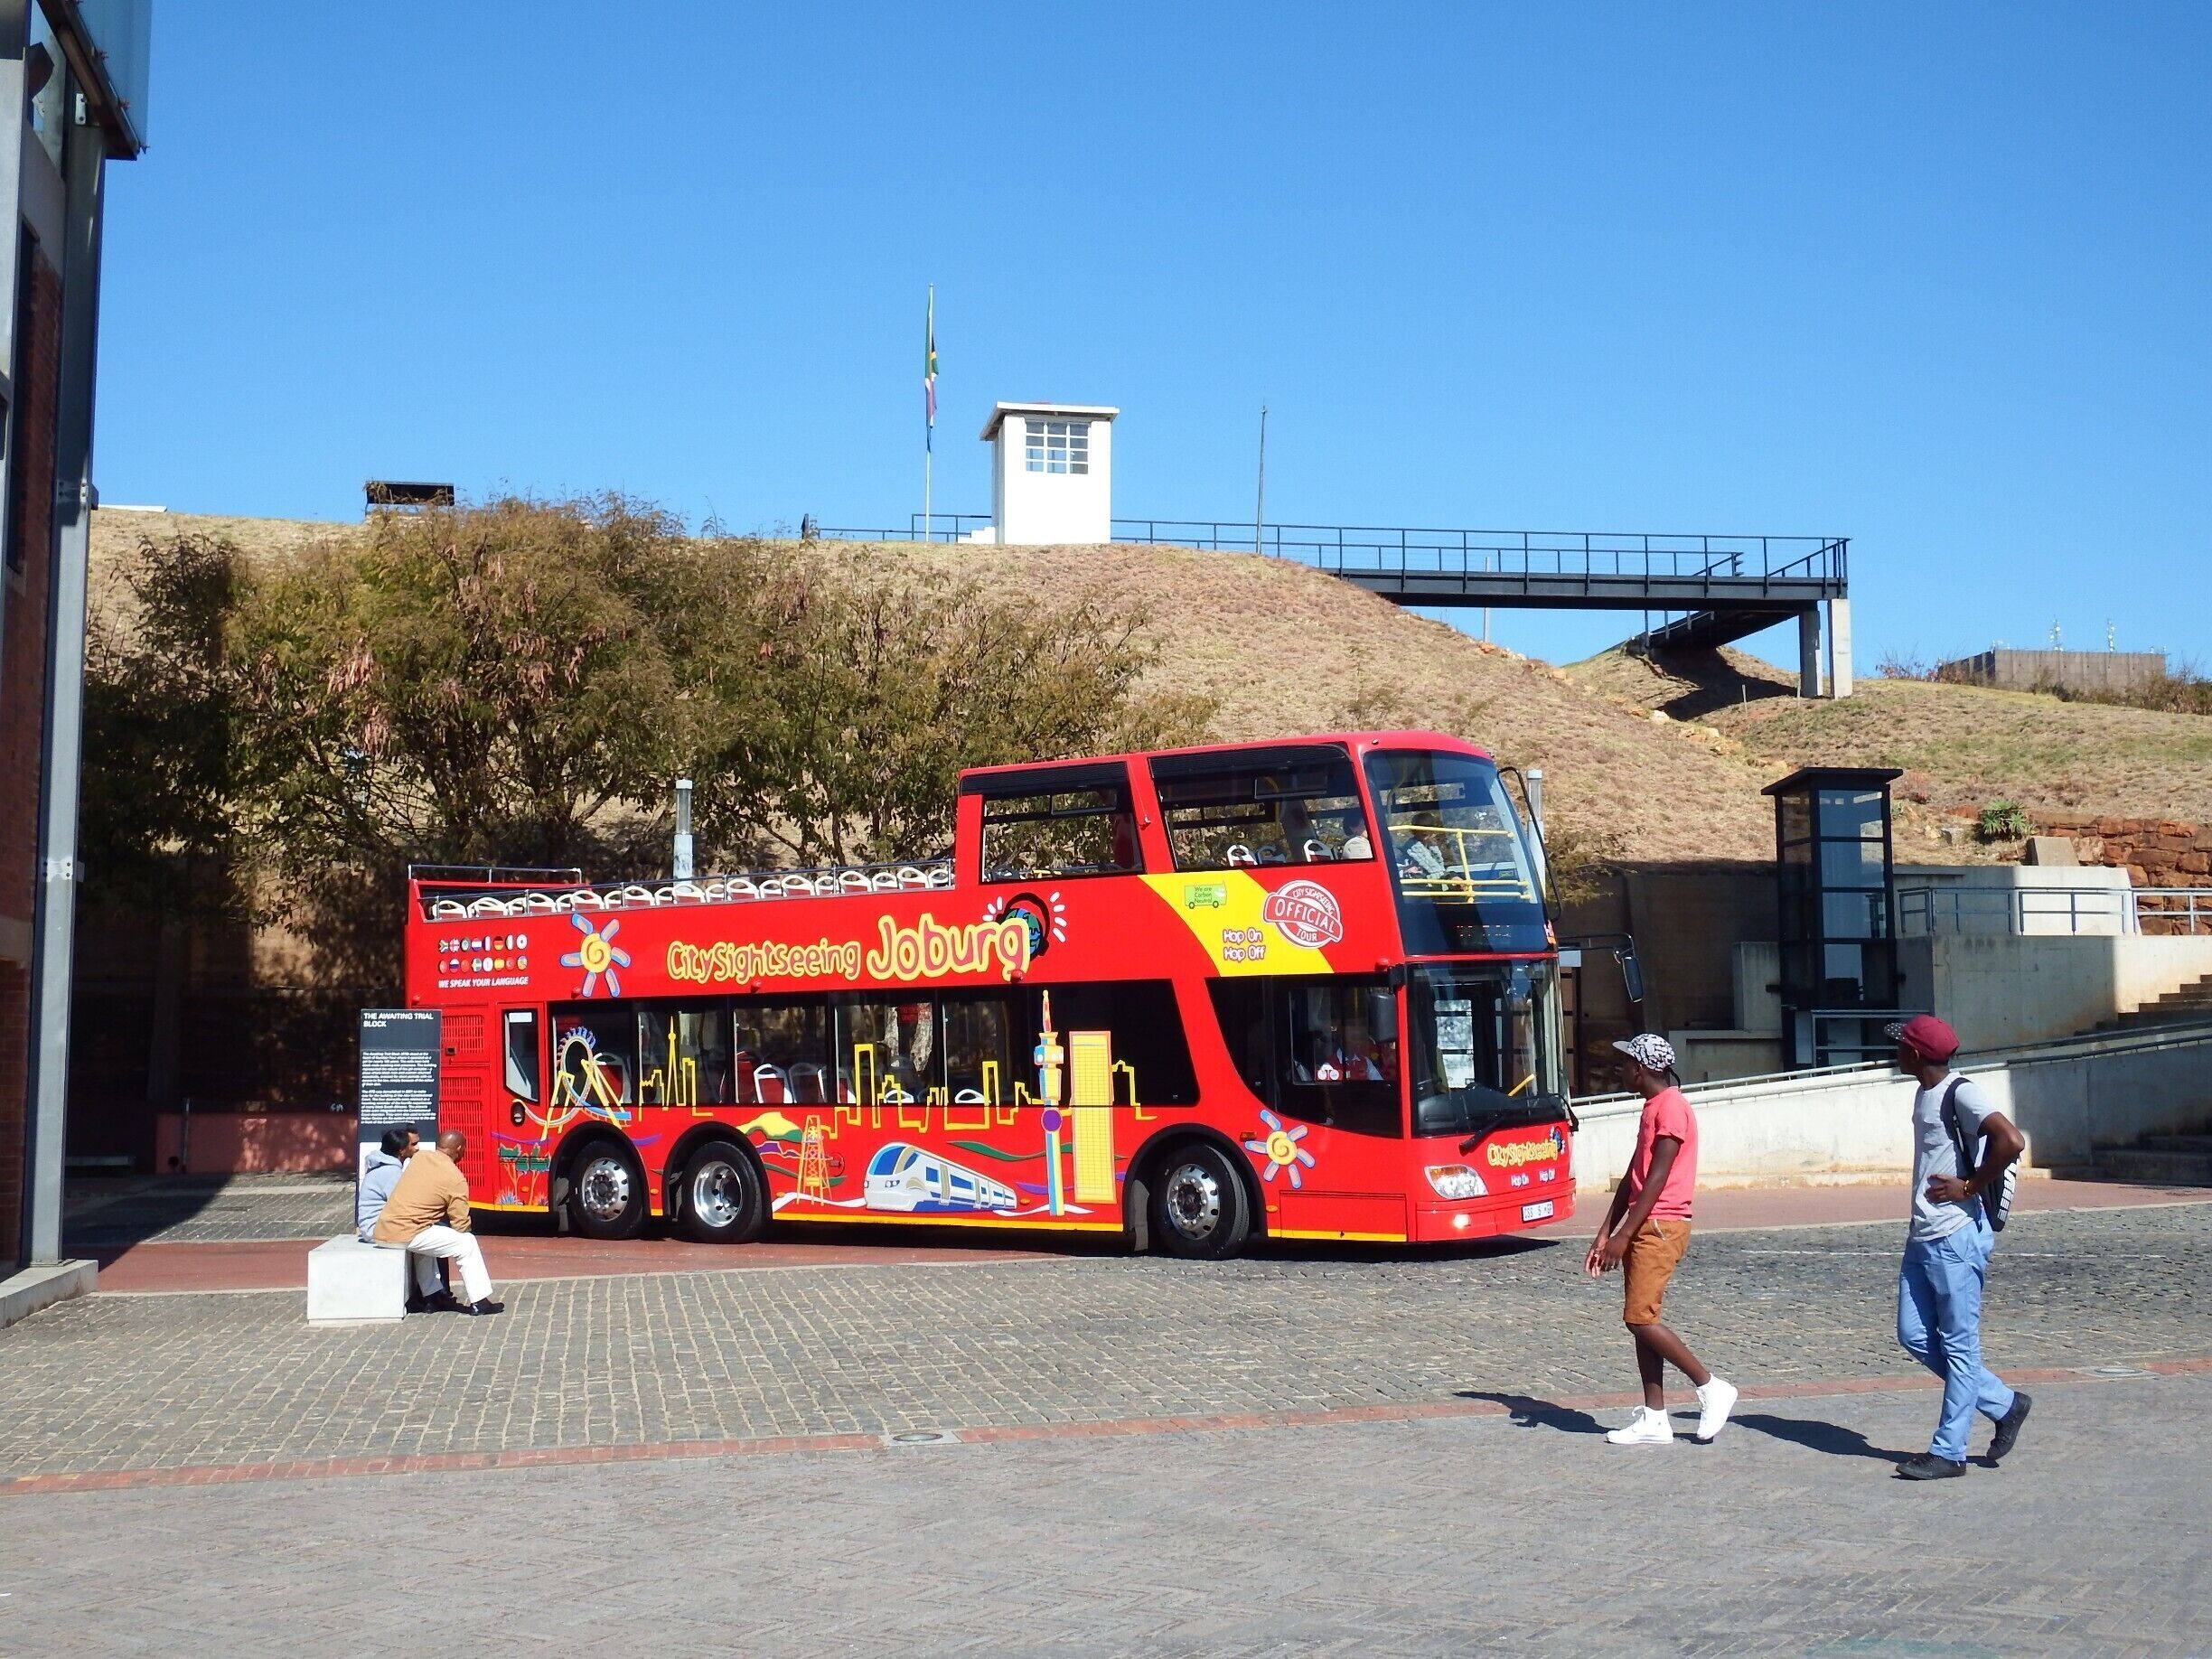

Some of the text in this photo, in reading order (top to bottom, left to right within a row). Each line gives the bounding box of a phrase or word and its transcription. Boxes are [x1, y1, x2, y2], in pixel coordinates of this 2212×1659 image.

[1292, 887, 1305, 898] CITY
[1274, 898, 1335, 933] OFFICIAL
[1223, 927, 1263, 945] Hop On
[1296, 928, 1317, 942] TOUR
[866, 913, 1030, 981] Joburg
[1223, 944, 1266, 963] Hop Off
[438, 976, 529, 989] WE SPEAK YOUR LANGUAGE
[363, 1012, 434, 1020] THE AWAITING TRIAL
[1511, 1175, 1522, 1187] Hop
[1539, 1170, 1548, 1183] Hop
